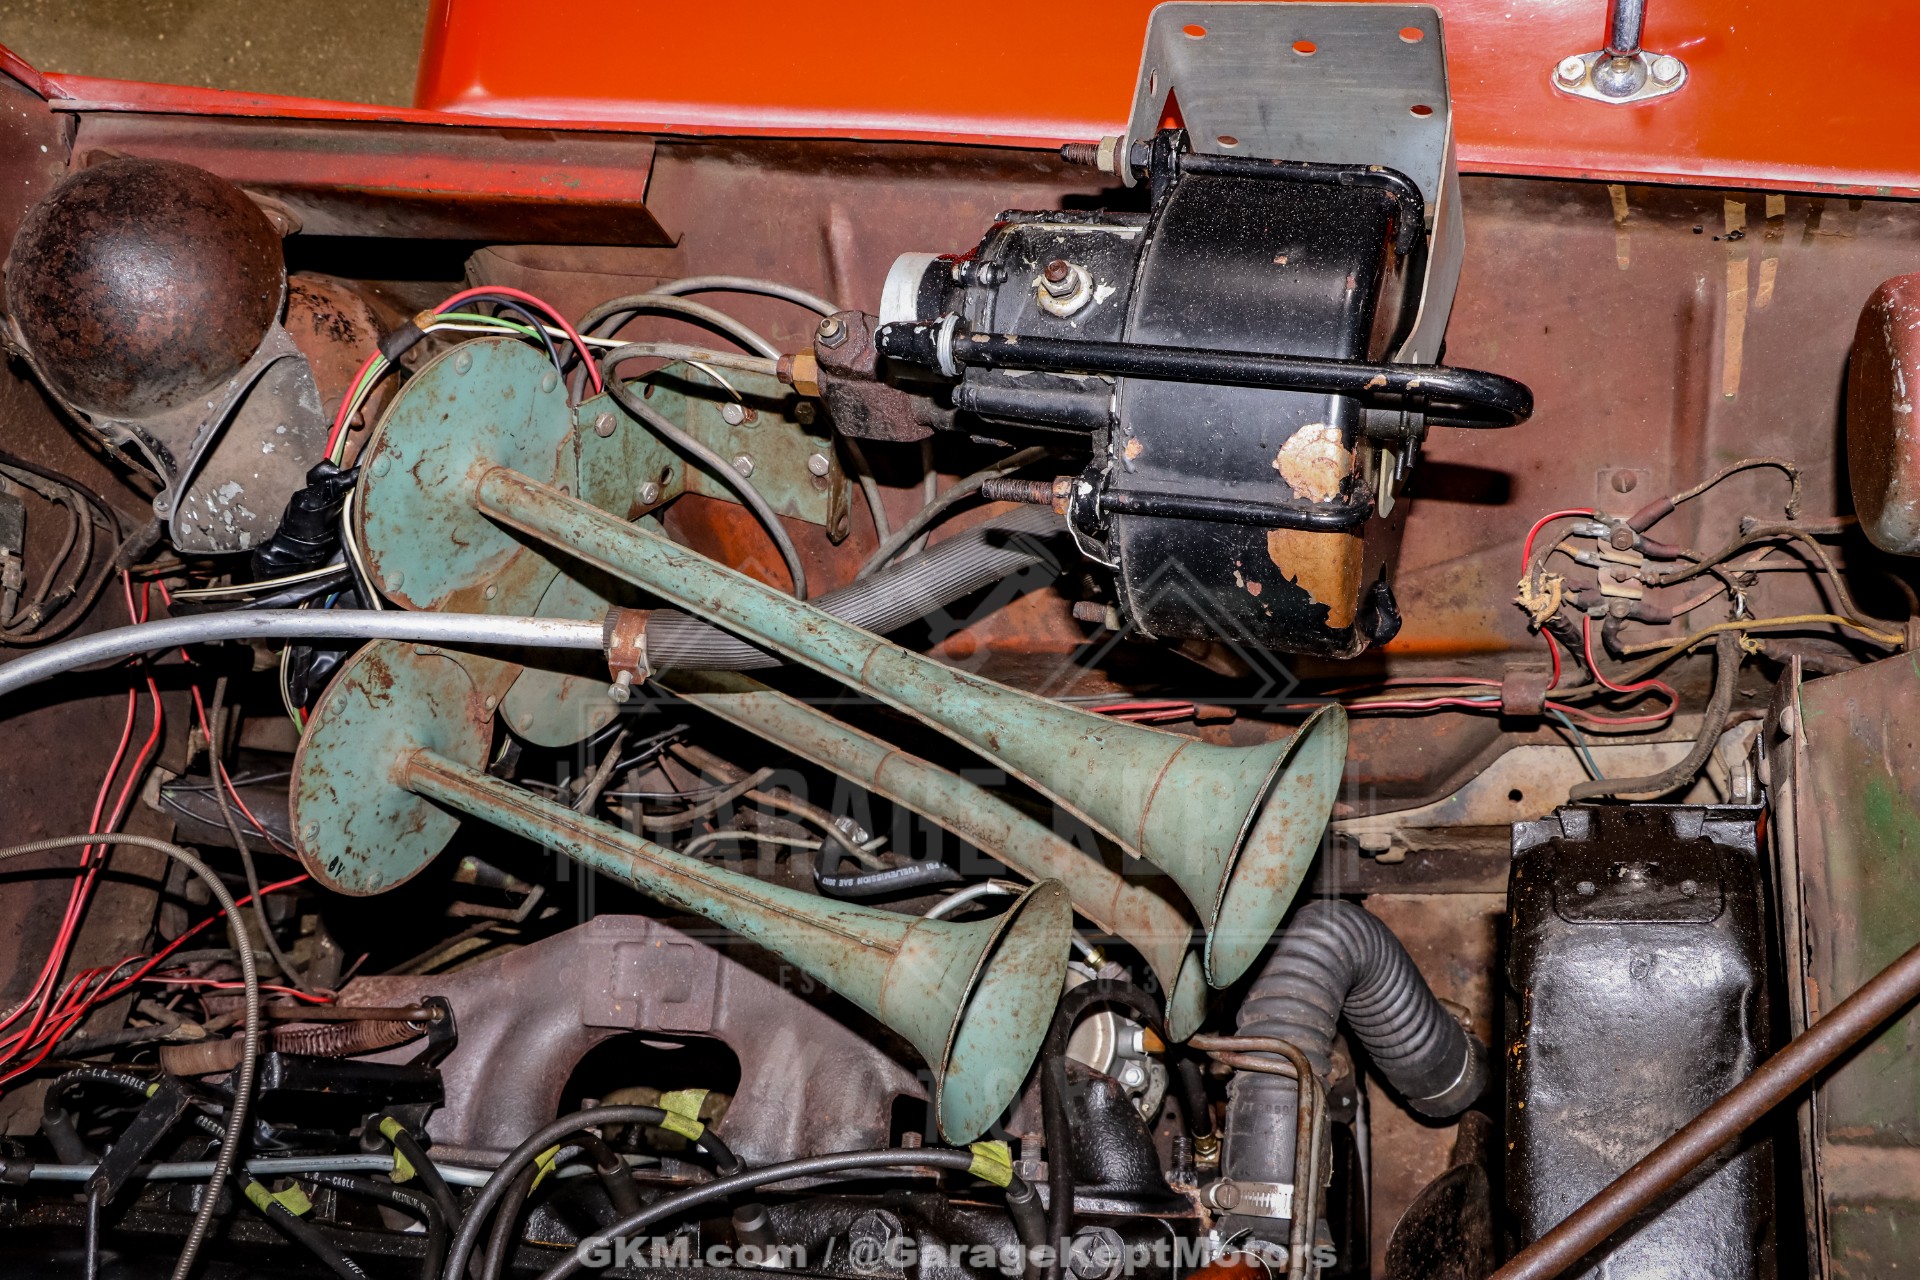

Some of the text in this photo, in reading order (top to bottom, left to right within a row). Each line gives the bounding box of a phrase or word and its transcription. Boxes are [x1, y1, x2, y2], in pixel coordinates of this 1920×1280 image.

[838, 877, 854, 887] SAE
[857, 865, 920, 886] FUEL/EMISSION
[119, 1073, 146, 1091] CABLE
[197, 1115, 227, 1138] PRESTO
